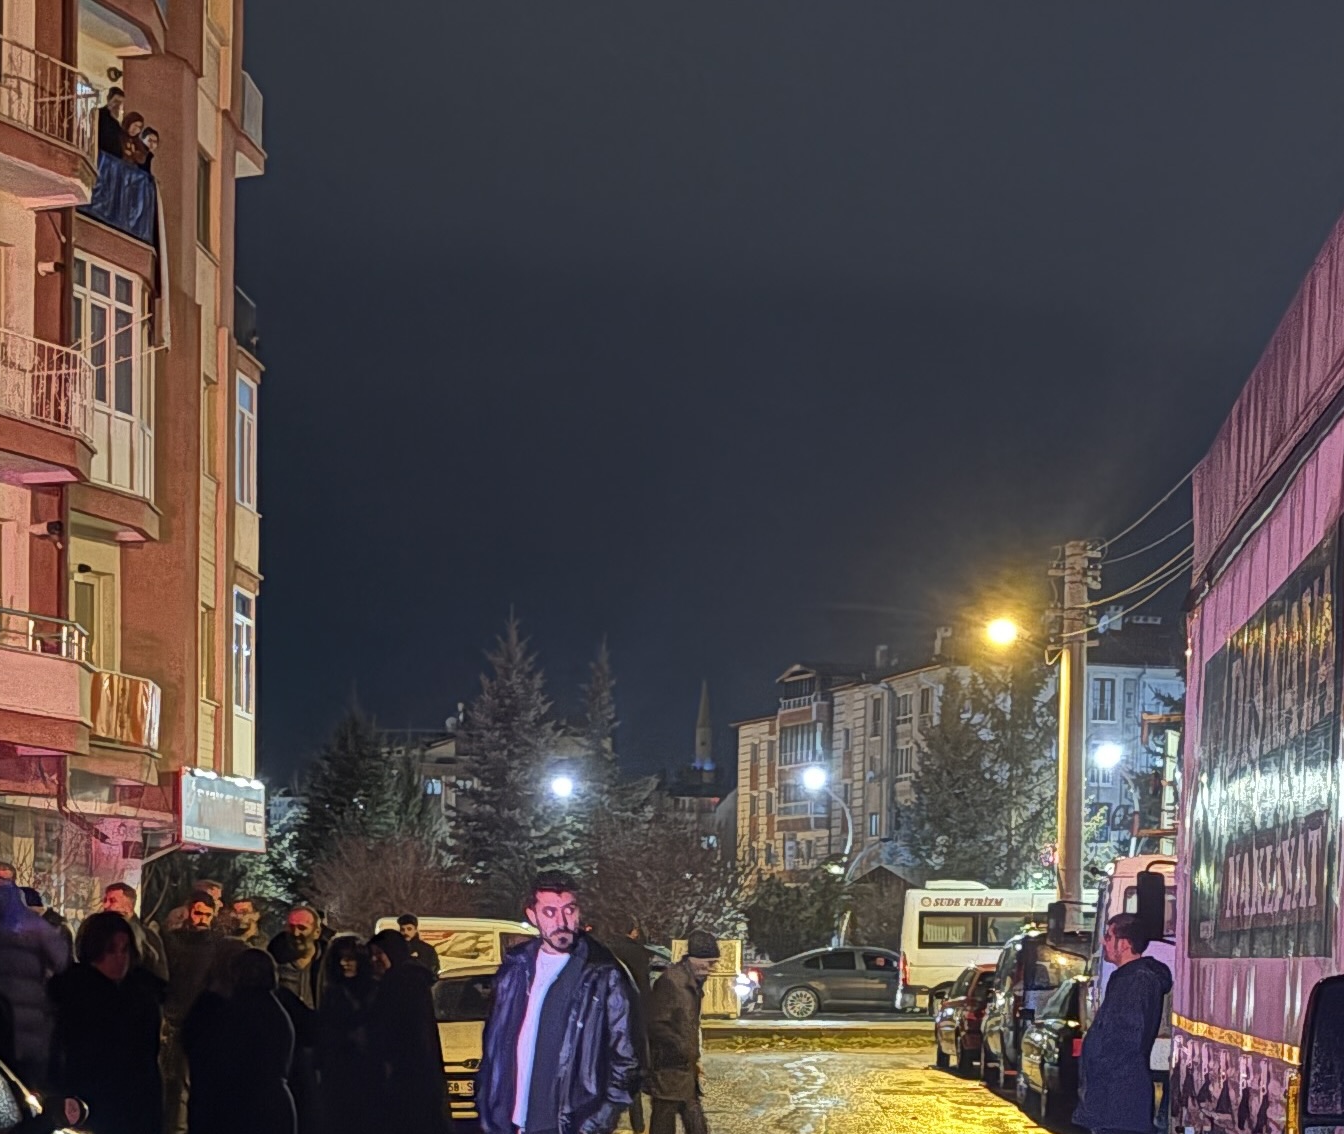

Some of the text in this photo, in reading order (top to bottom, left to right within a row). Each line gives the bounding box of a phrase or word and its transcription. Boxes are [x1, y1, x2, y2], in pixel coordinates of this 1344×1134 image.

[1225, 825, 1323, 918] NAKLİYAT
[932, 896, 1004, 907] SUDE TURİZM
